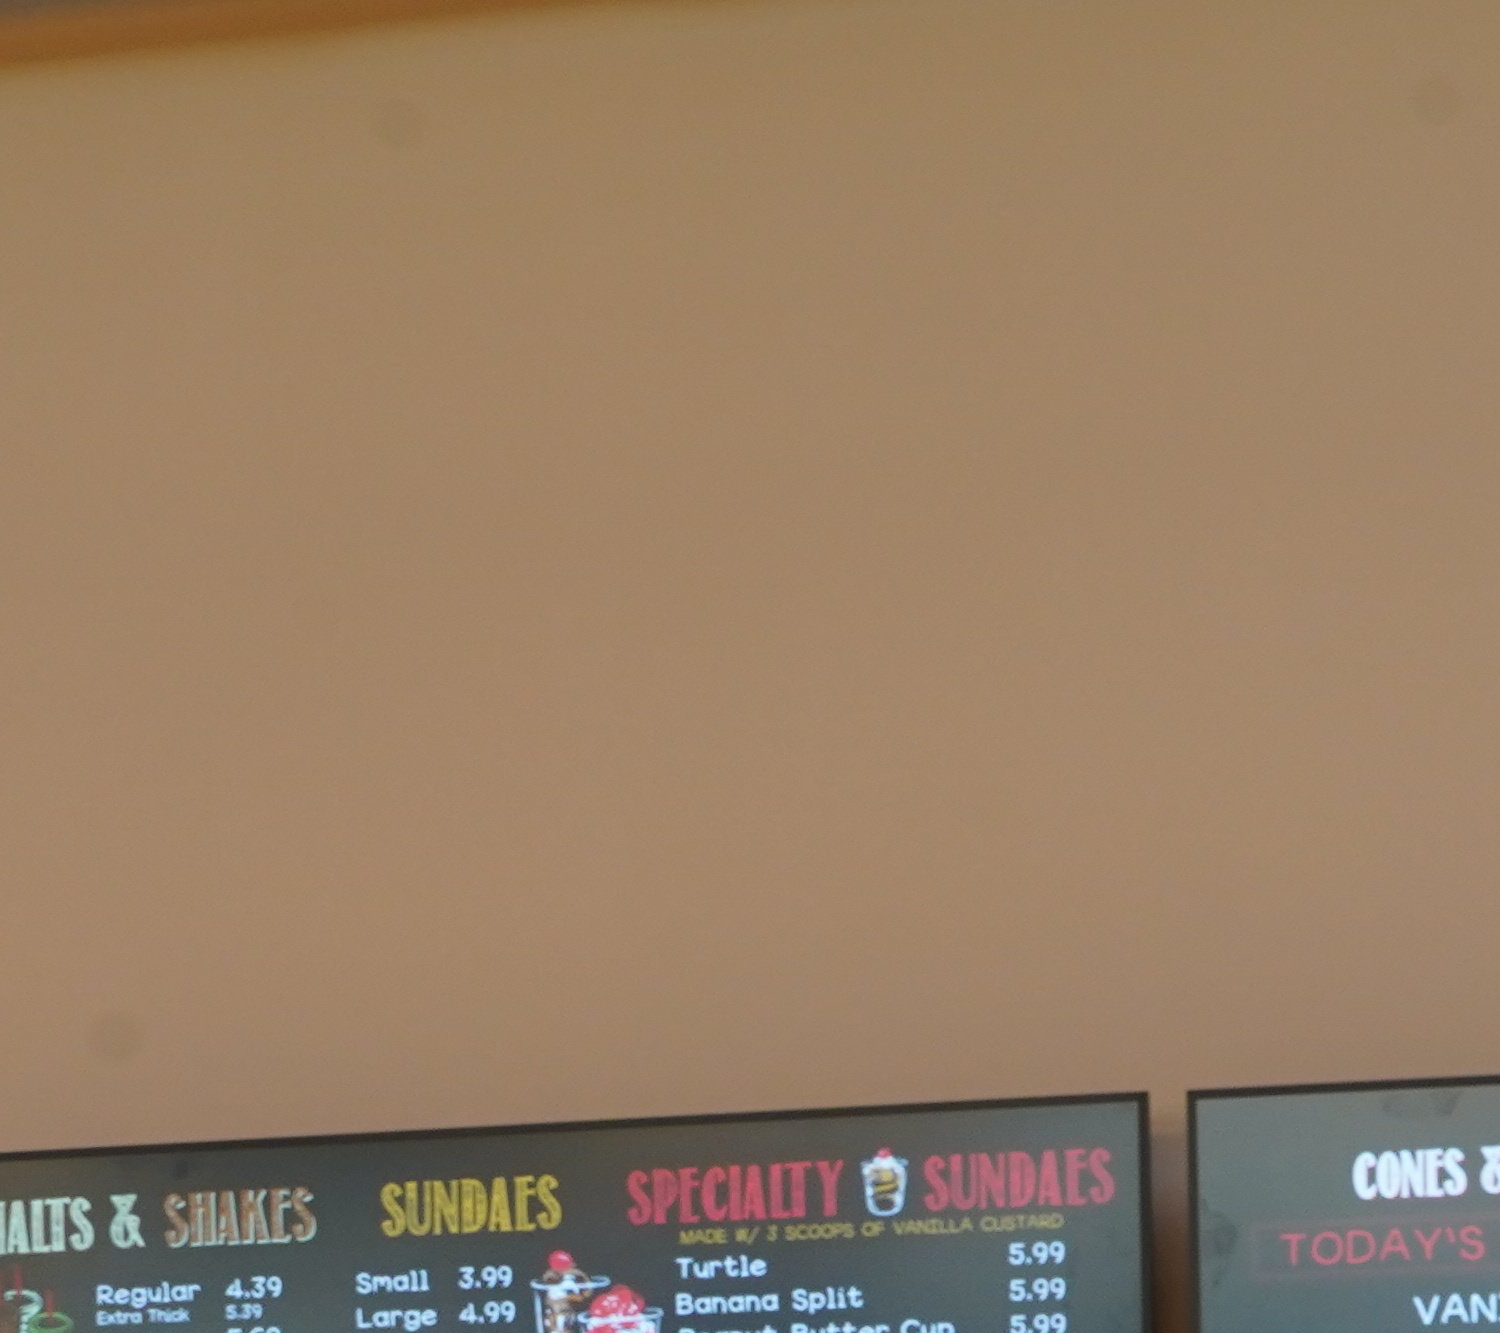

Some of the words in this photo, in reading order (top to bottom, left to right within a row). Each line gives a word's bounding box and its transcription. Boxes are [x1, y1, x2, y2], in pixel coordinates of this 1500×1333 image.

[627, 1160, 844, 1225] SPECIALTY
[924, 1147, 1115, 1211] SUNDAES
[1352, 1148, 1467, 1200] CONES
[110, 1194, 145, 1249] &
[164, 1187, 317, 1248] SHAKES
[381, 1174, 562, 1237] SUNDAES
[1009, 1241, 1065, 1265] 5.99
[1280, 1225, 1486, 1265] TODAY'S
[356, 1270, 429, 1294] Small
[459, 1266, 512, 1289] 3.99
[676, 1255, 767, 1279] Turtle
[96, 1282, 201, 1309] Regular
[226, 1276, 282, 1299] 4.39
[356, 1308, 437, 1332] Large
[459, 1301, 516, 1323] 4.99
